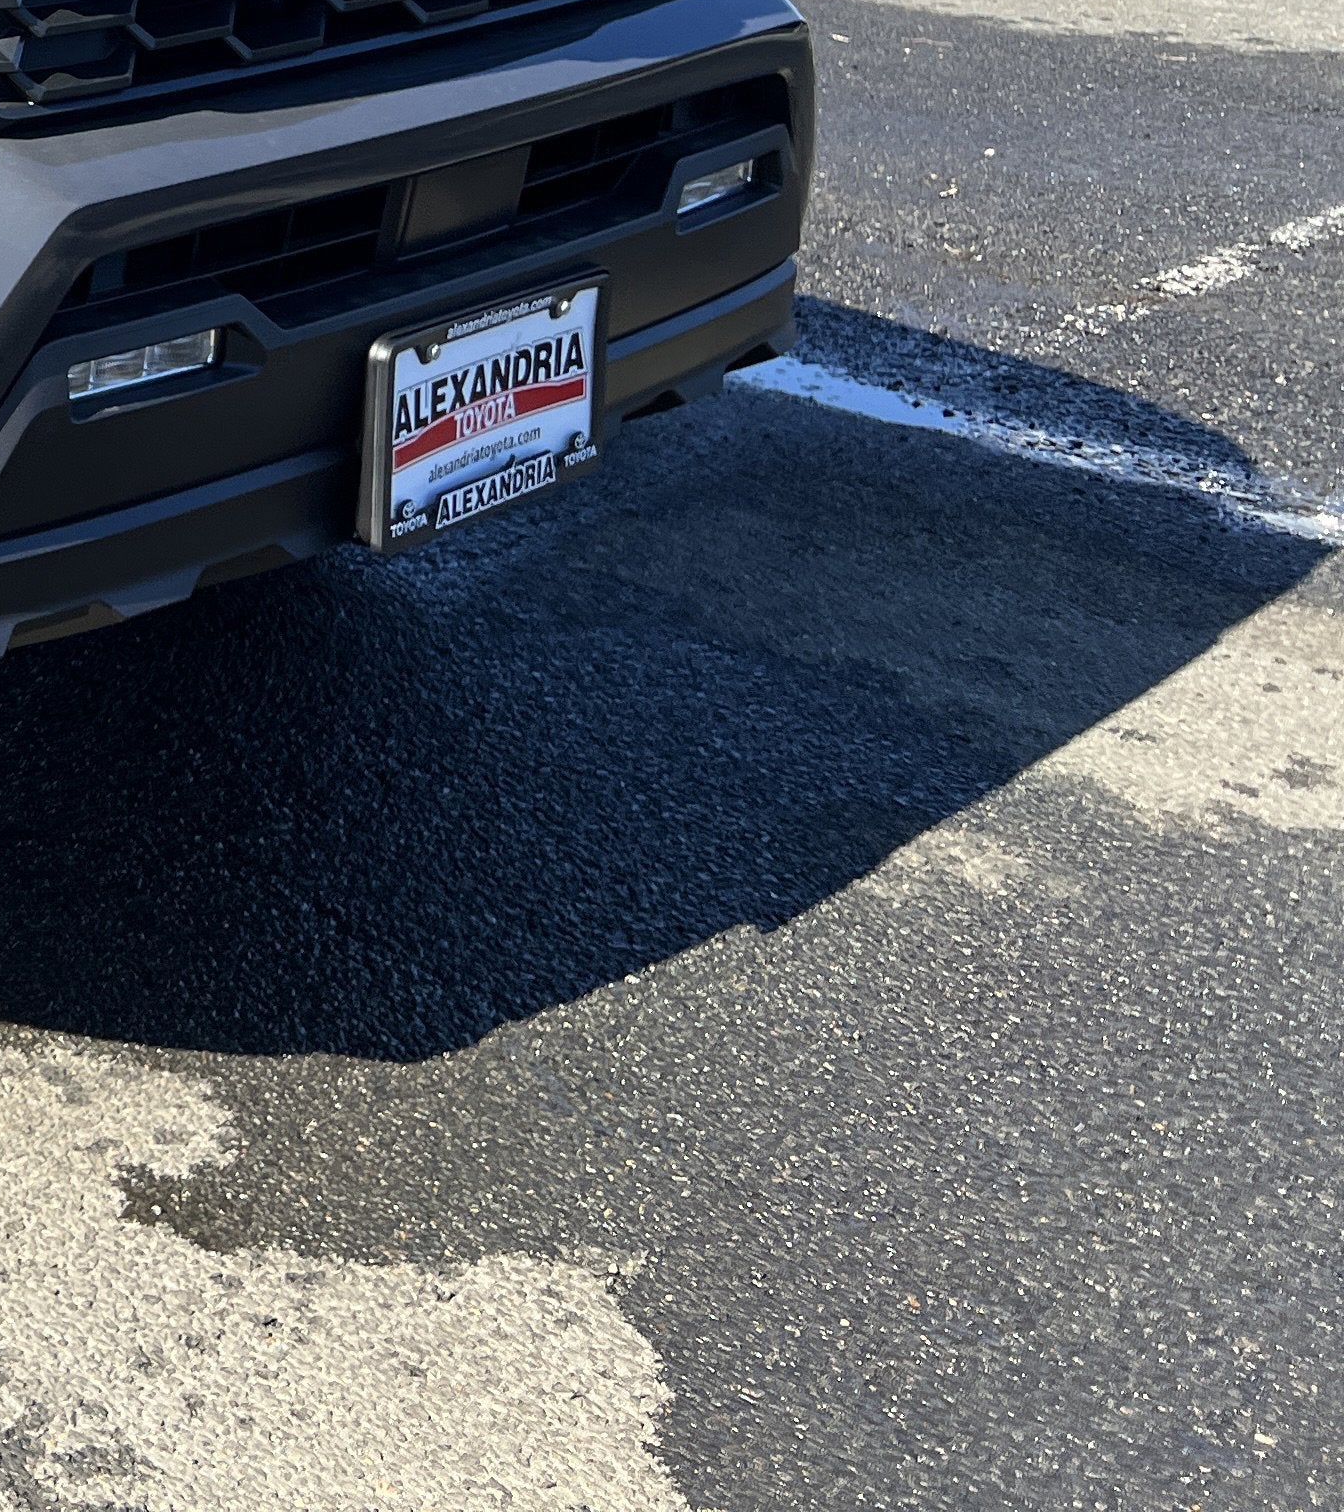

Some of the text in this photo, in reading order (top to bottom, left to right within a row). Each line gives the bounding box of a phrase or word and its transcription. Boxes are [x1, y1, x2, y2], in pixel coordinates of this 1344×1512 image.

[394, 331, 586, 441] ALEXANDRIA
[453, 393, 517, 440] TOYOTA
[428, 426, 541, 483] alexandriatoyota.com
[563, 443, 598, 468] TOYOTA
[437, 454, 556, 526] ALEXANDRIA
[389, 512, 429, 539] TOYOTA
